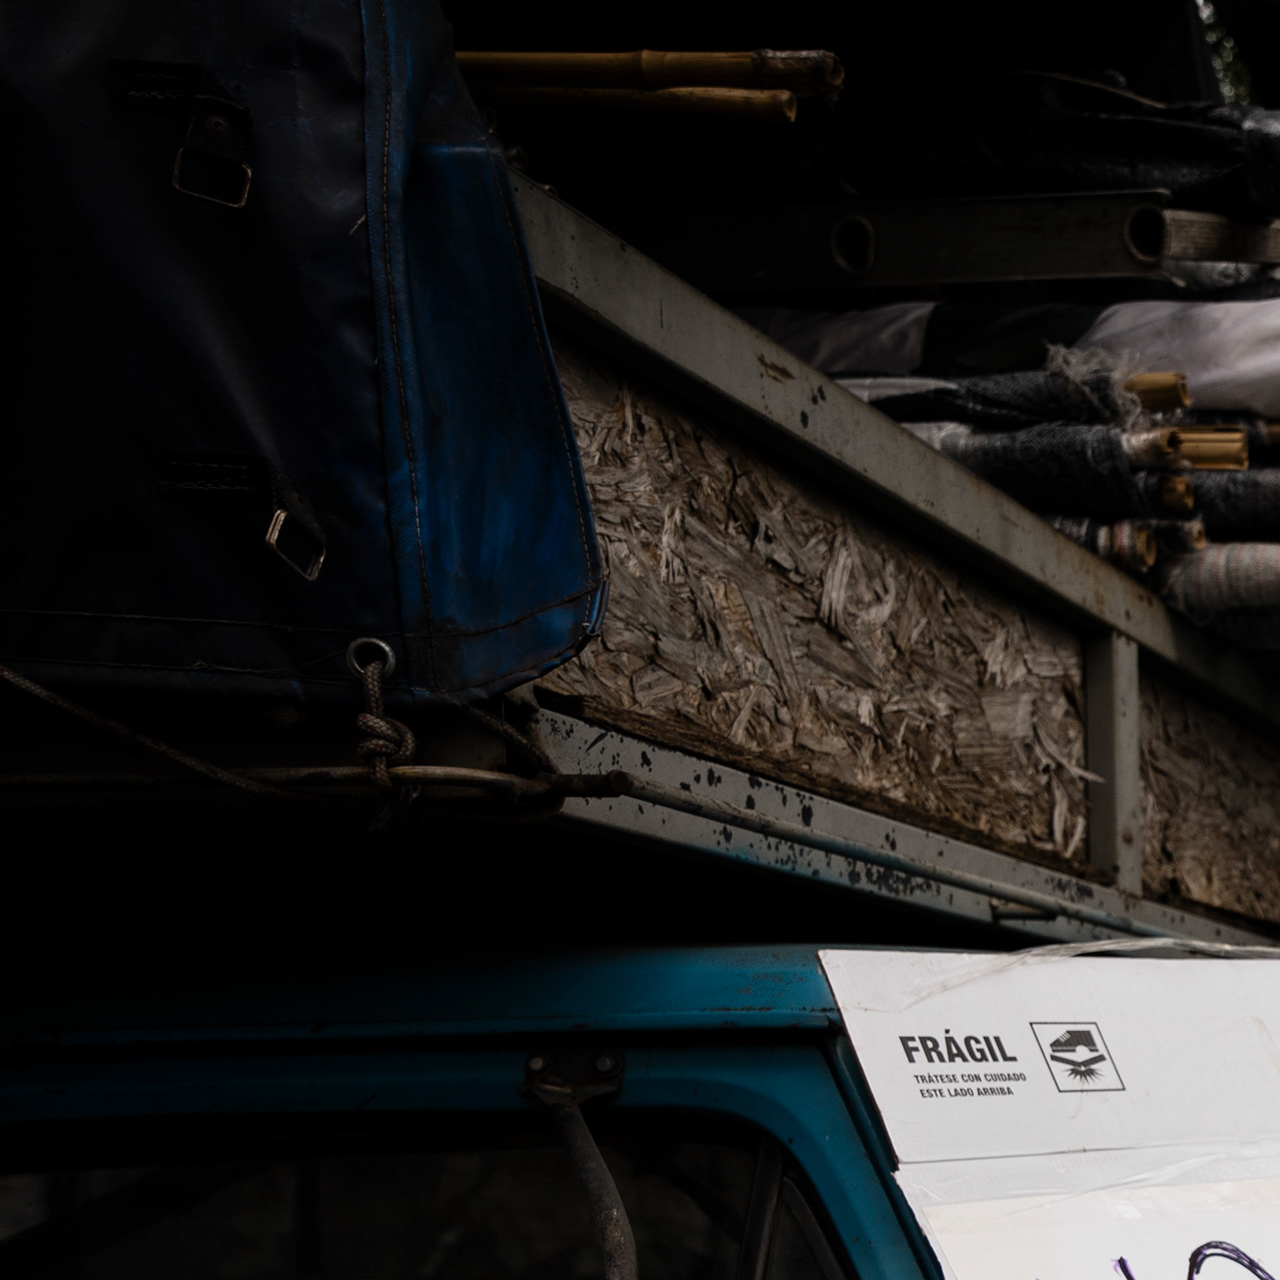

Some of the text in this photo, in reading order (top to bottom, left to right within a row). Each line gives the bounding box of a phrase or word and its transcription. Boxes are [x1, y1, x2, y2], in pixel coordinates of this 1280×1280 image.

[899, 1029, 1018, 1064] FRÁGIL
[914, 1072, 1026, 1084] TRÁTESE CON CUIDADO
[920, 1086, 1014, 1099] ESTE LADO ARRIBA
